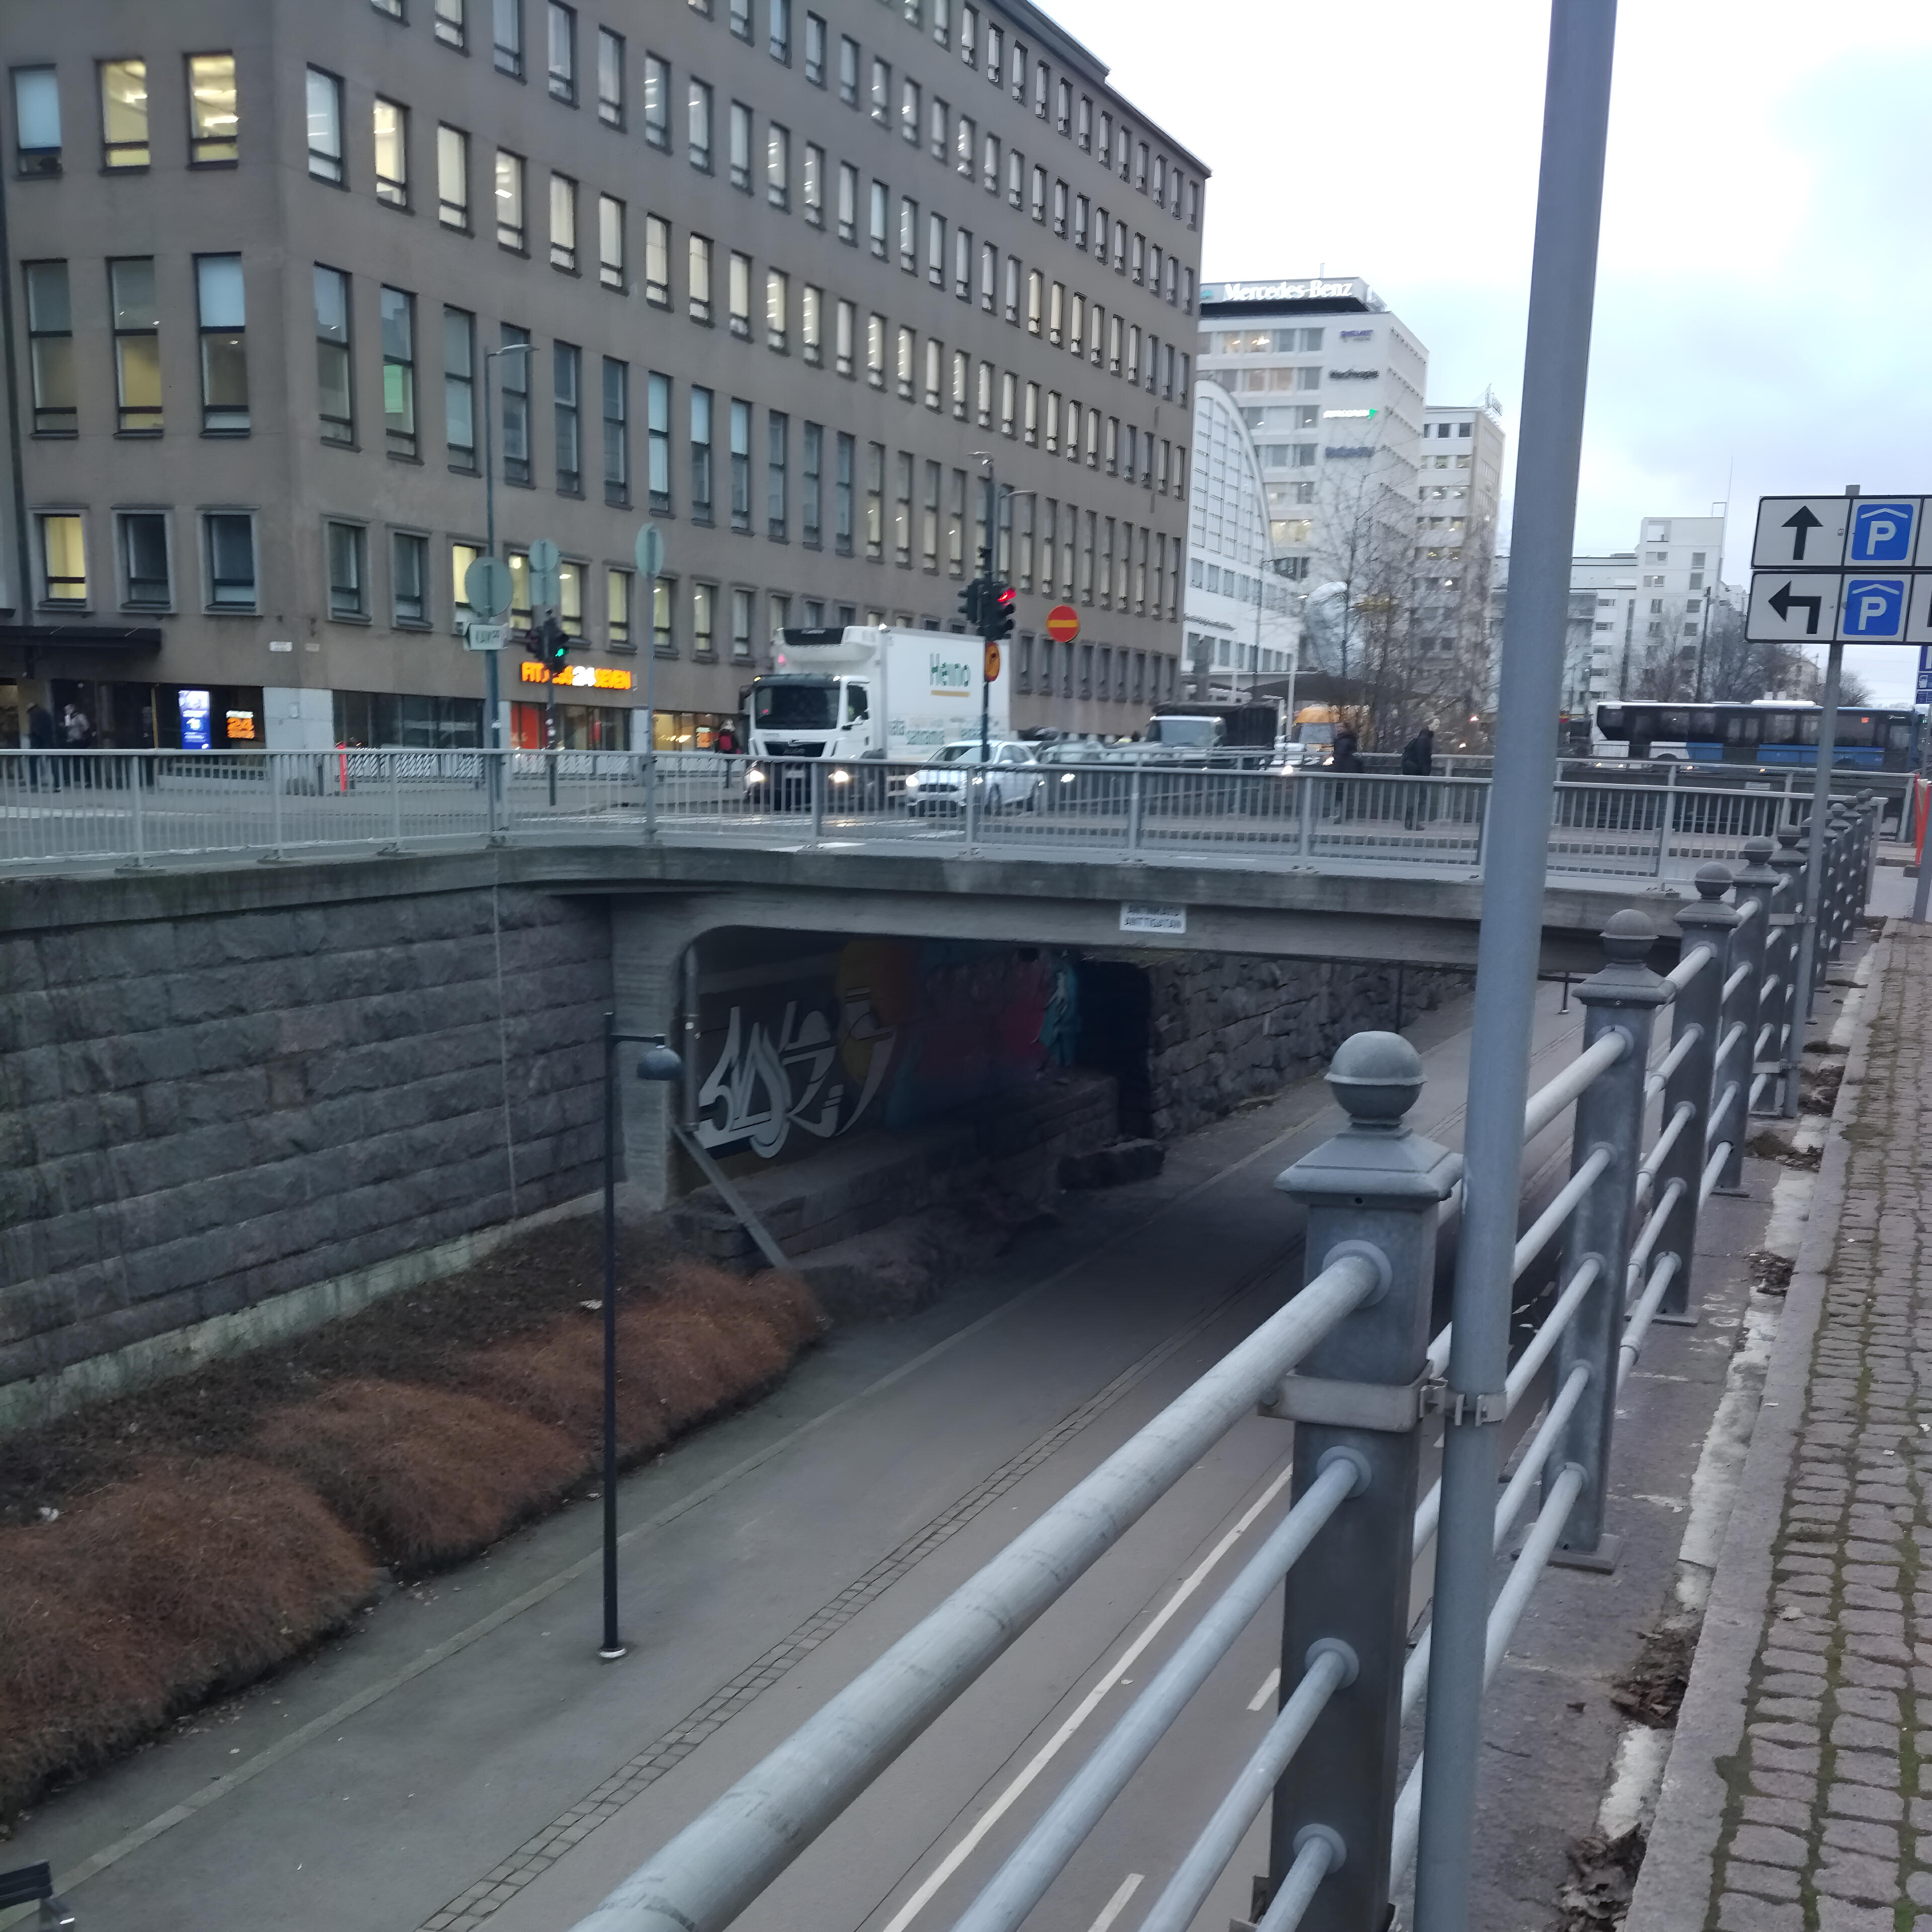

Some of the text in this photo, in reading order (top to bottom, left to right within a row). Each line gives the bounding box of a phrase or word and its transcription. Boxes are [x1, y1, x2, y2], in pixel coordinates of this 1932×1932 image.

[1225, 280, 1352, 301] Mercedes-Benz
[1866, 520, 1897, 555] P
[1858, 596, 1887, 630] P
